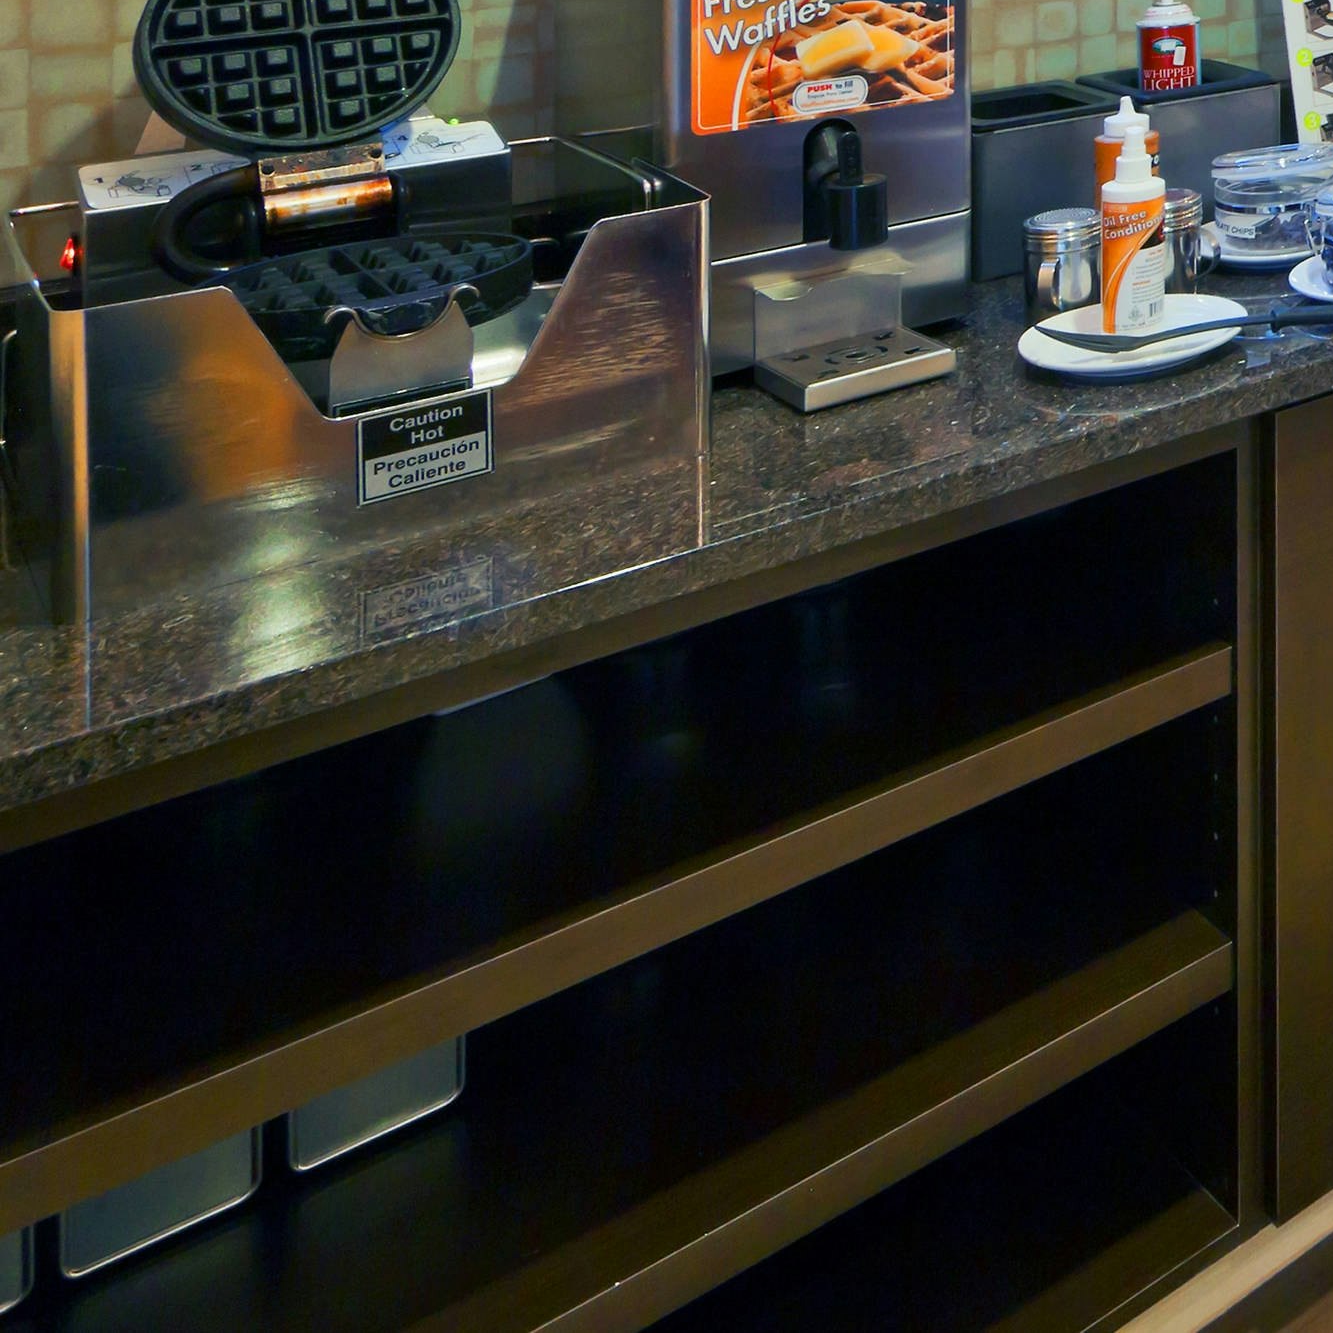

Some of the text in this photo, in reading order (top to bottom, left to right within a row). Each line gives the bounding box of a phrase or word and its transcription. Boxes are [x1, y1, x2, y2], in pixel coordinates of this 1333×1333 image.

[1143, 66, 1195, 78] WHIPPED
[807, 83, 832, 93] PUSH
[1143, 75, 1194, 91] LIGHT
[1104, 210, 1147, 227] Oil Free
[1231, 226, 1254, 236] CHIPS
[389, 405, 464, 433] Caution
[410, 425, 445, 444] Hot
[373, 439, 480, 475] Precaución
[388, 459, 466, 489] Caliente
